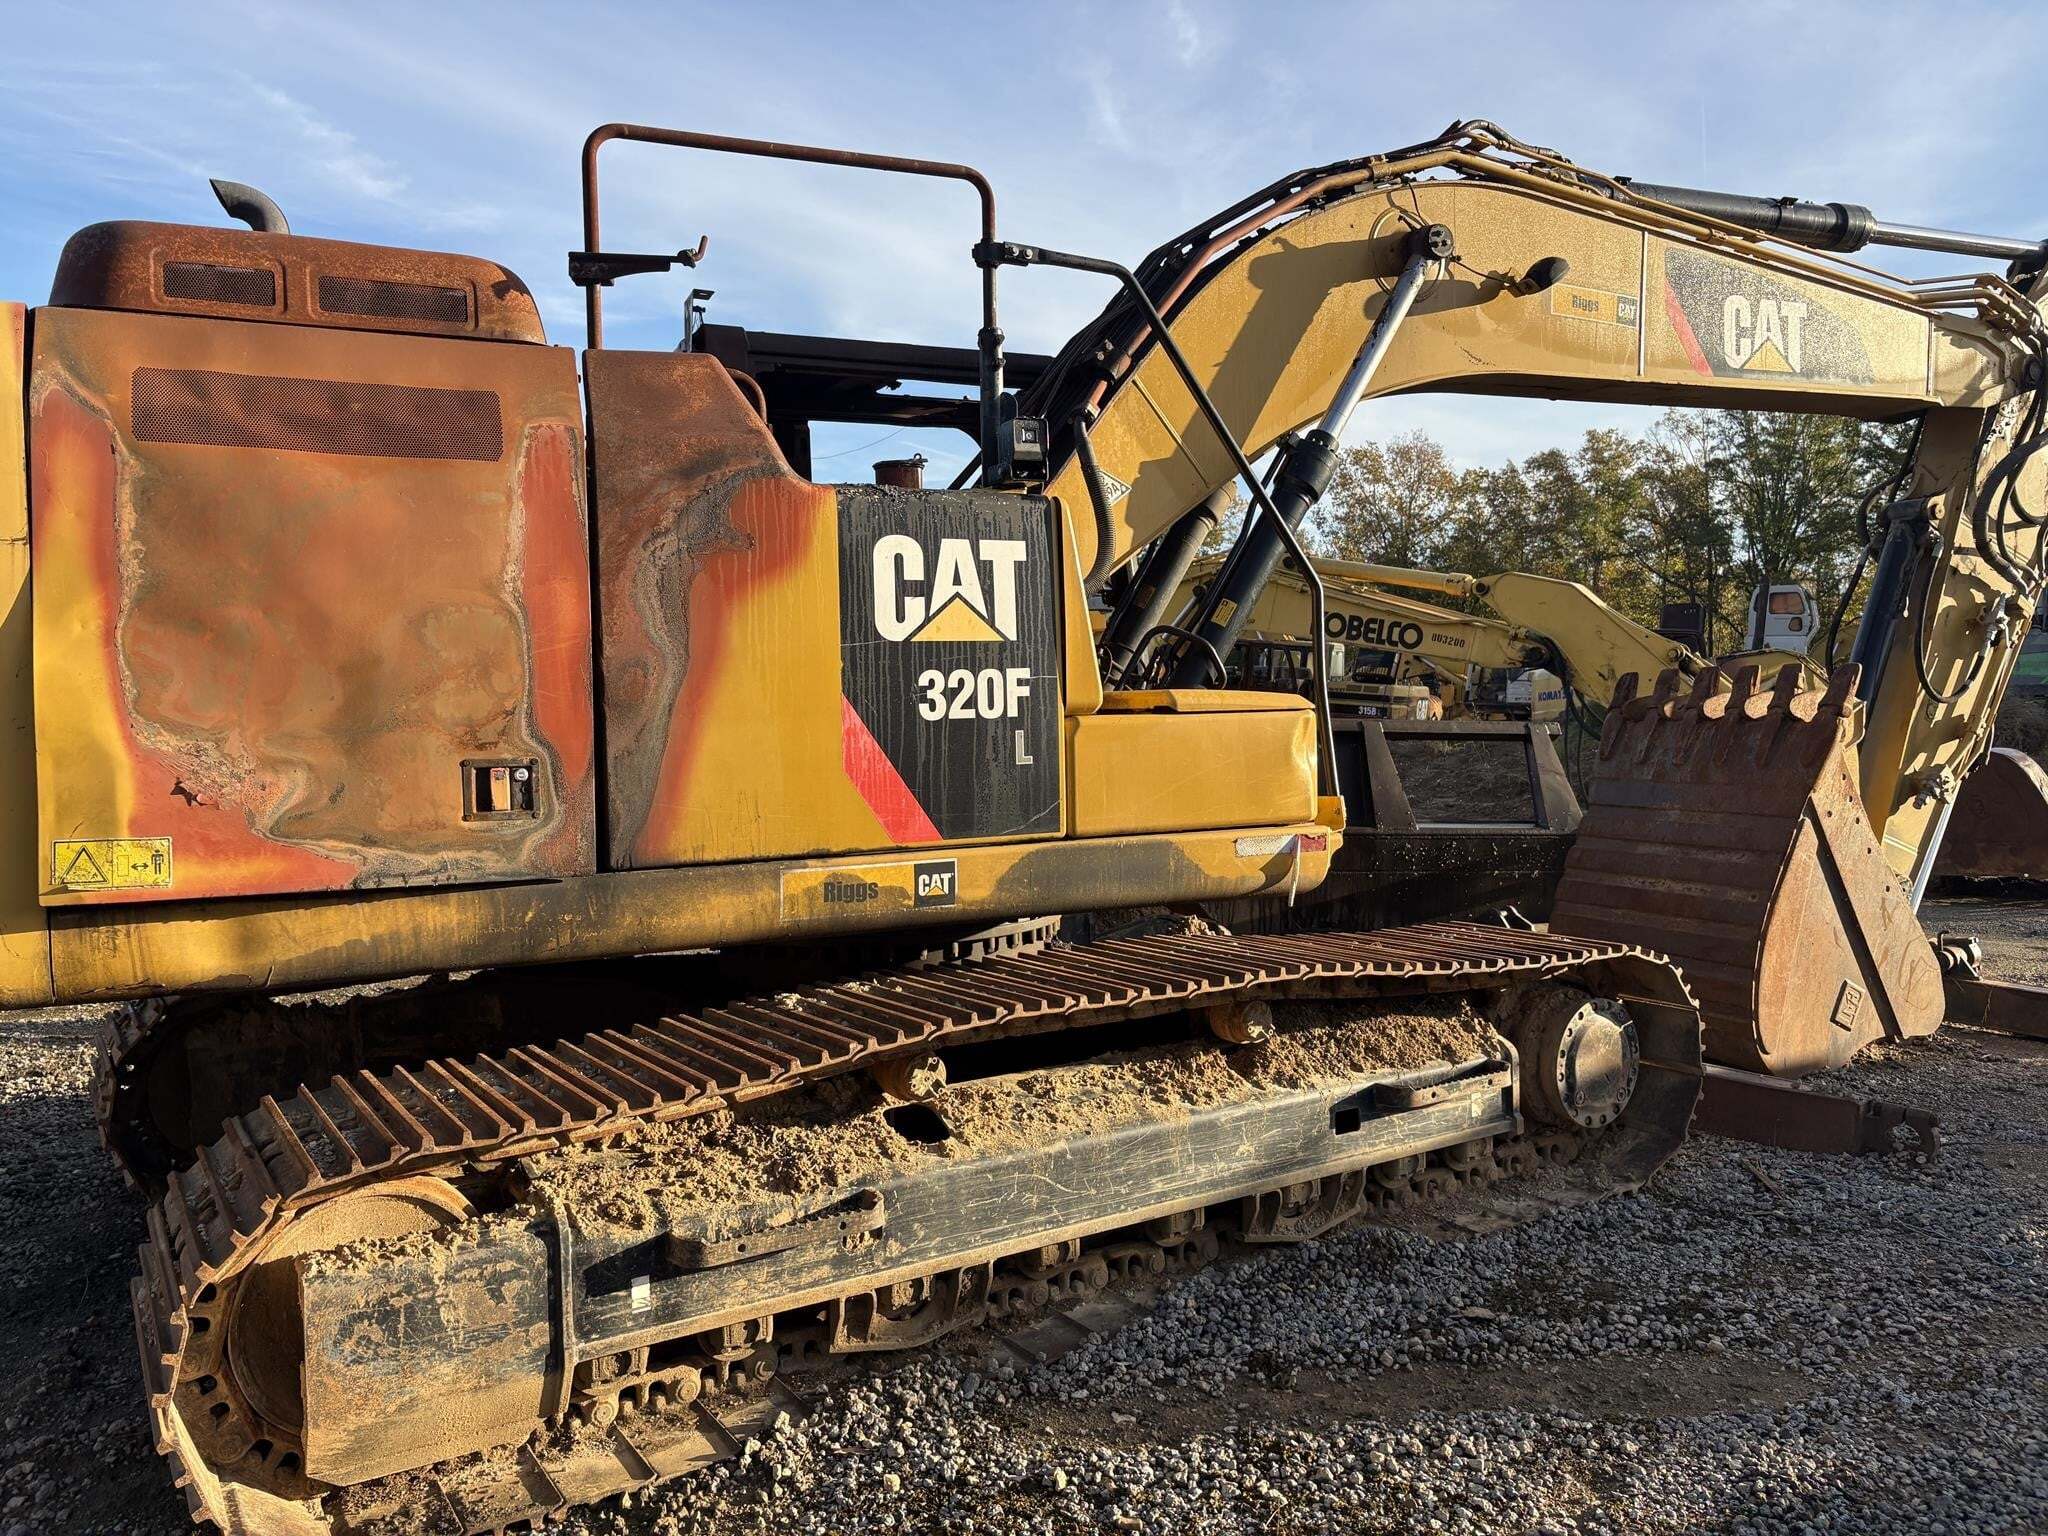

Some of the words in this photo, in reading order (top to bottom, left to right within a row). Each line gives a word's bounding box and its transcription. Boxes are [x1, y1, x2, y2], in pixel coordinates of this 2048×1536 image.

[1572, 295, 1599, 312] Riggs
[1618, 303, 1637, 320] CAT
[1723, 295, 1807, 373] CAT
[873, 534, 1026, 642] CAT
[1310, 611, 1424, 650] OBELCO
[918, 667, 1031, 721] 320F
[1015, 730, 1033, 765] L
[823, 881, 879, 903] Riggs
[918, 873, 953, 897] CAT
